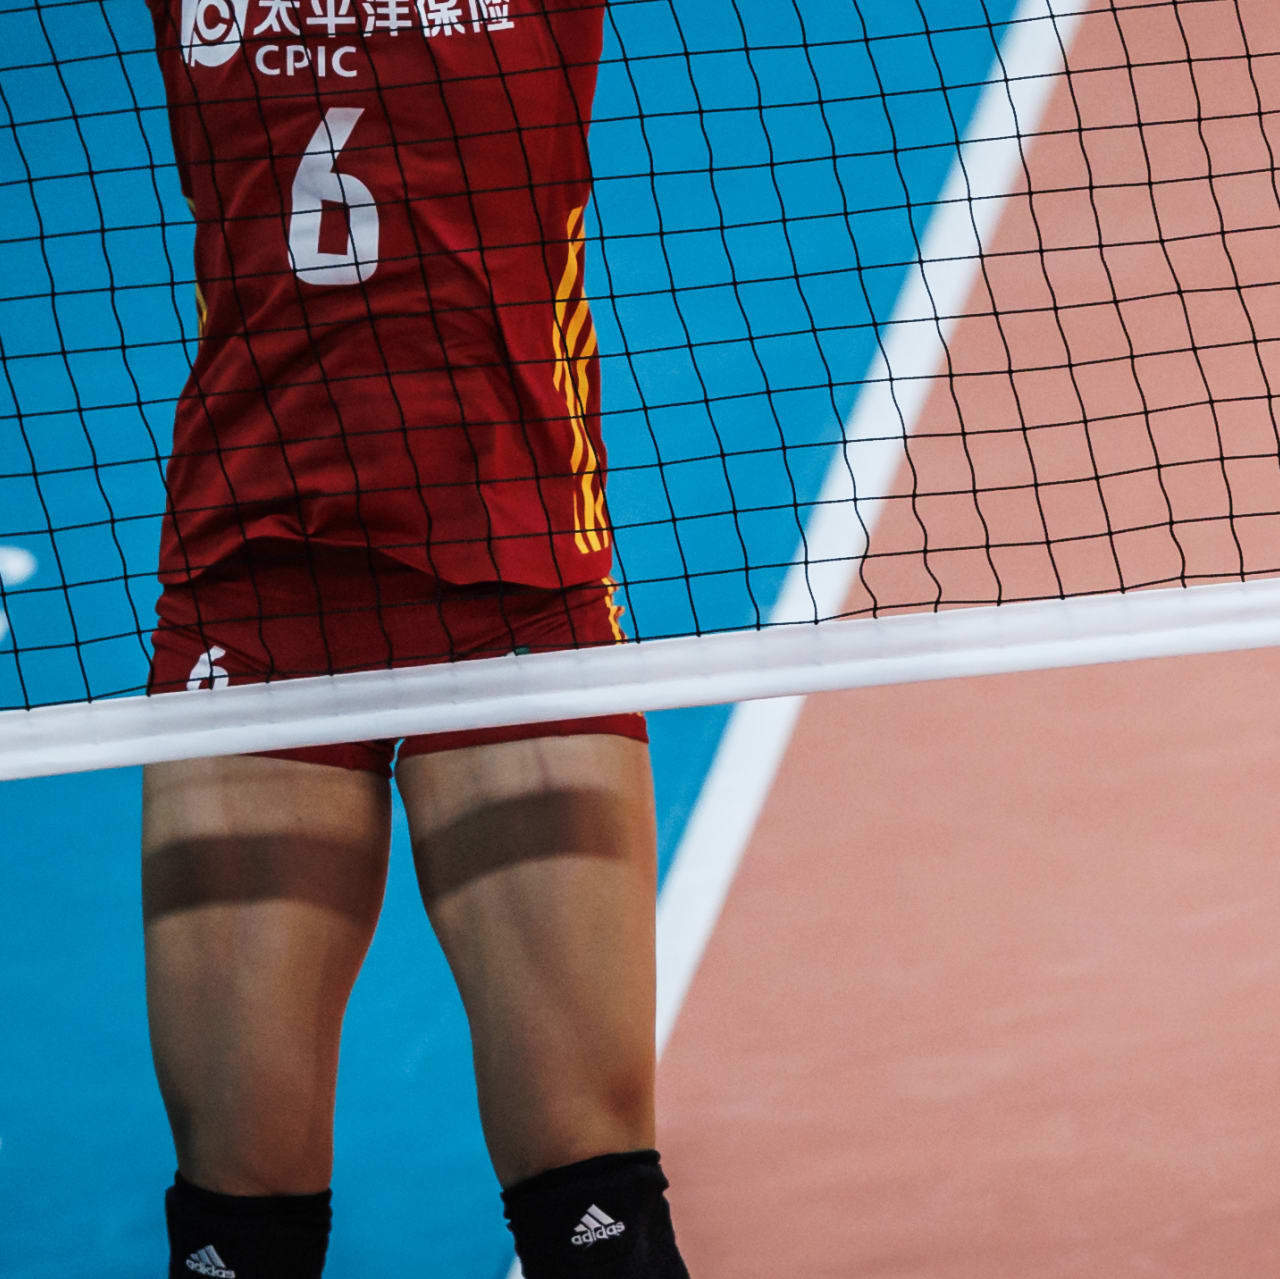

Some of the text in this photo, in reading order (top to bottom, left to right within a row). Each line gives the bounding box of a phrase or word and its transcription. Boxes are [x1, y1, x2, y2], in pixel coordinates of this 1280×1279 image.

[255, 43, 358, 78] CPIC
[288, 106, 380, 286] 6
[571, 1220, 626, 1247] adidas
